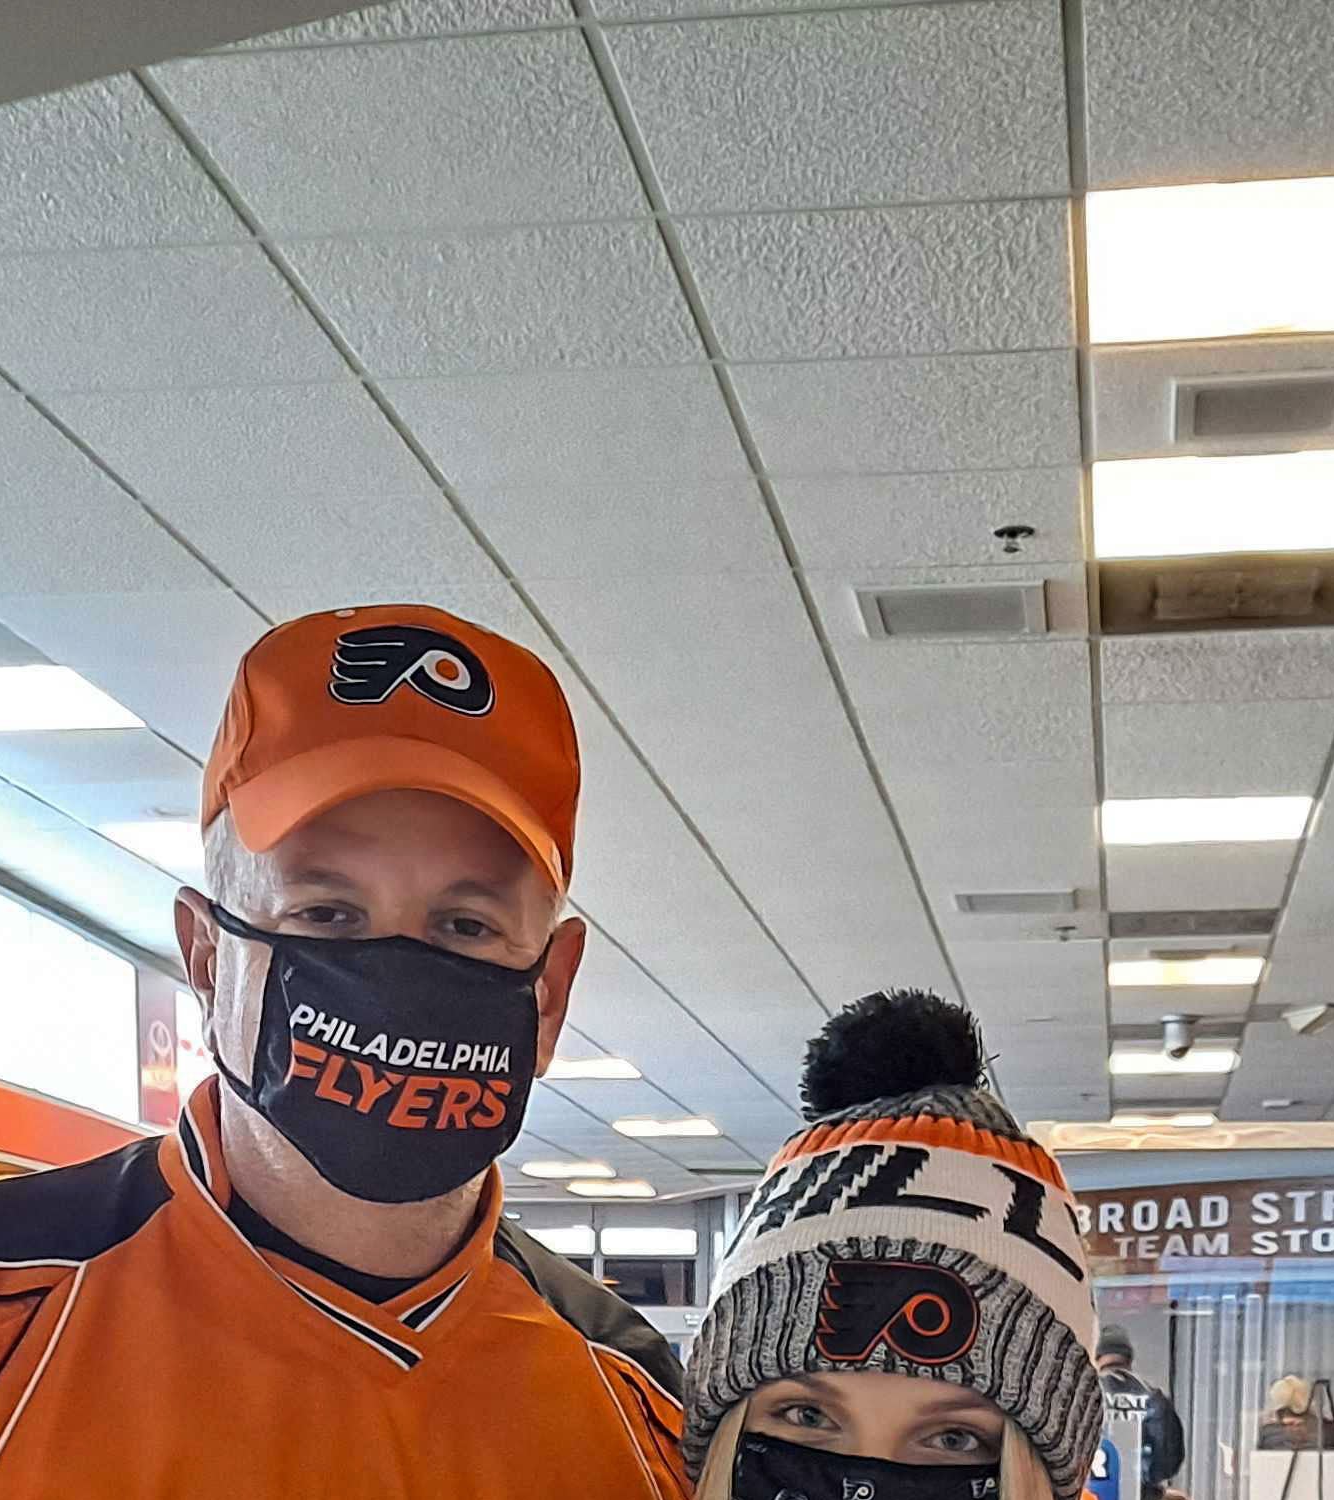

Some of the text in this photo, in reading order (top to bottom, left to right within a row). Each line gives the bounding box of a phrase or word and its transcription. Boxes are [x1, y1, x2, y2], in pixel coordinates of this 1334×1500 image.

[290, 1003, 511, 1073] PHILADELPHIA
[290, 1039, 513, 1130] FLYERS
[1075, 1194, 1229, 1236] BROAD
[1114, 1232, 1229, 1259] TEAM
